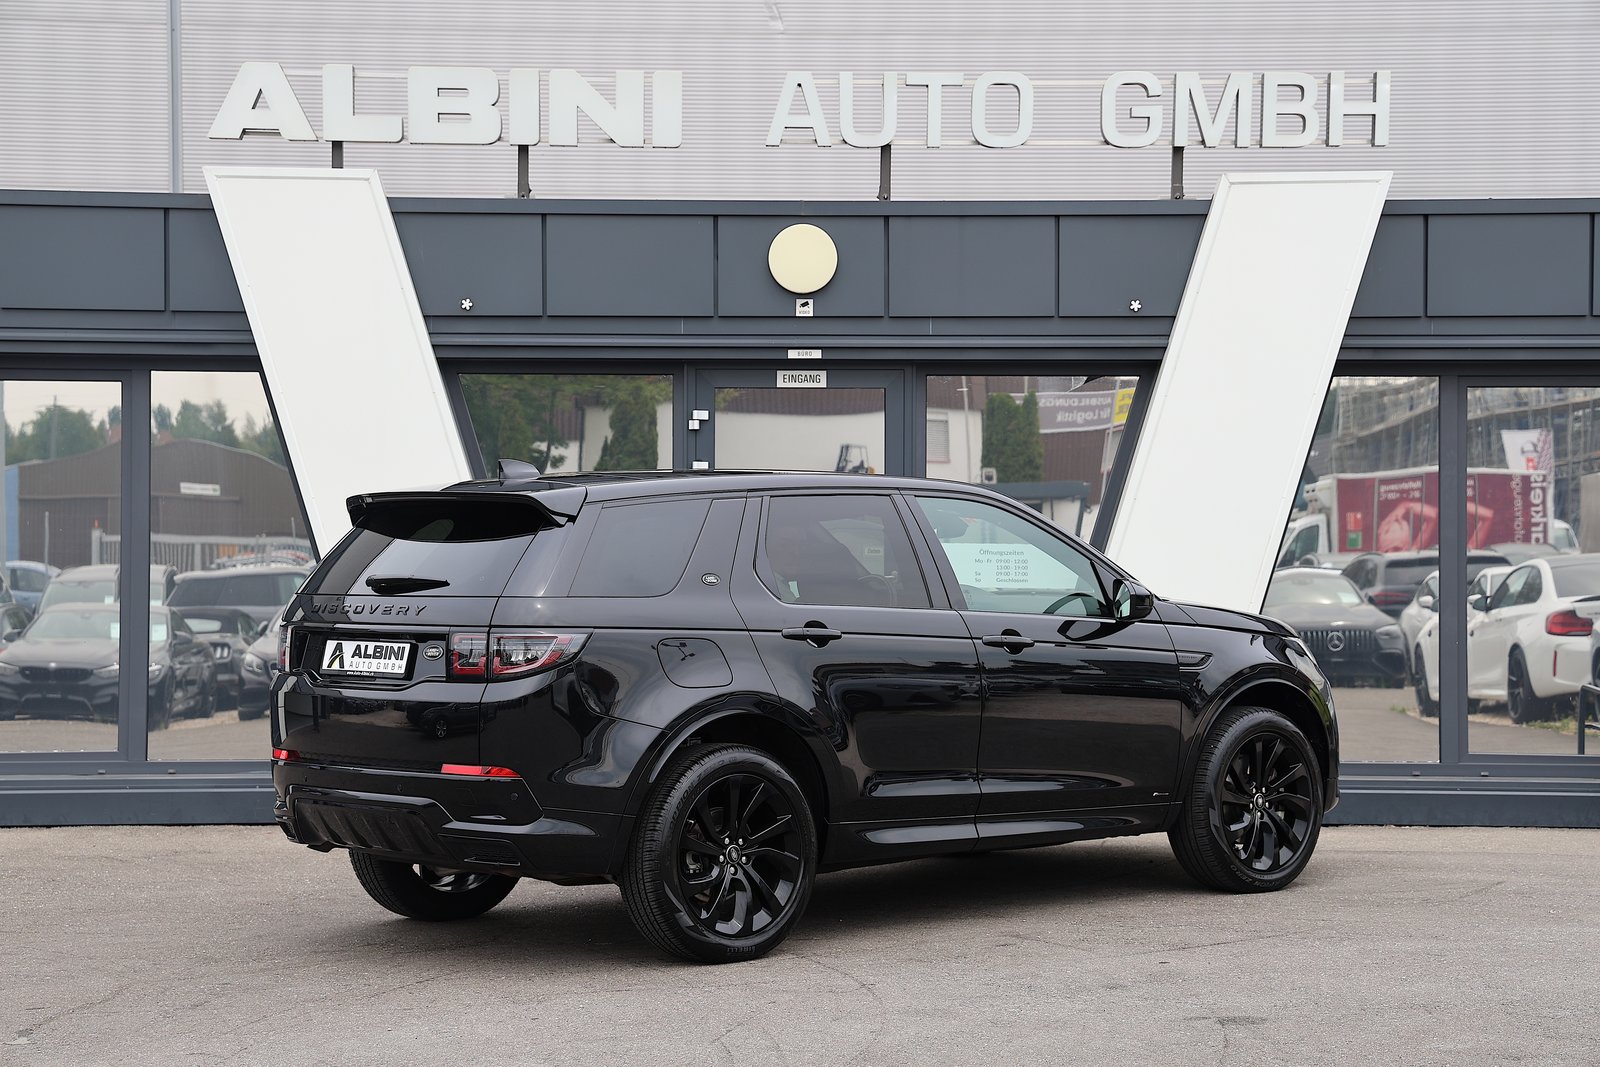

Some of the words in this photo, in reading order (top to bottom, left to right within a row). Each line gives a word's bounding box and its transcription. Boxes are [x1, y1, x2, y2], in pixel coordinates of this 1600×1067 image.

[207, 61, 682, 148] ALBINI
[765, 70, 1034, 149] AUTO
[1100, 70, 1391, 149] GMBH
[782, 374, 821, 384] EINGANG
[311, 603, 427, 616] DISCOVERY
[351, 644, 406, 661] ALBINI
[349, 660, 373, 670] AUTO
[376, 661, 403, 671] GMBH
